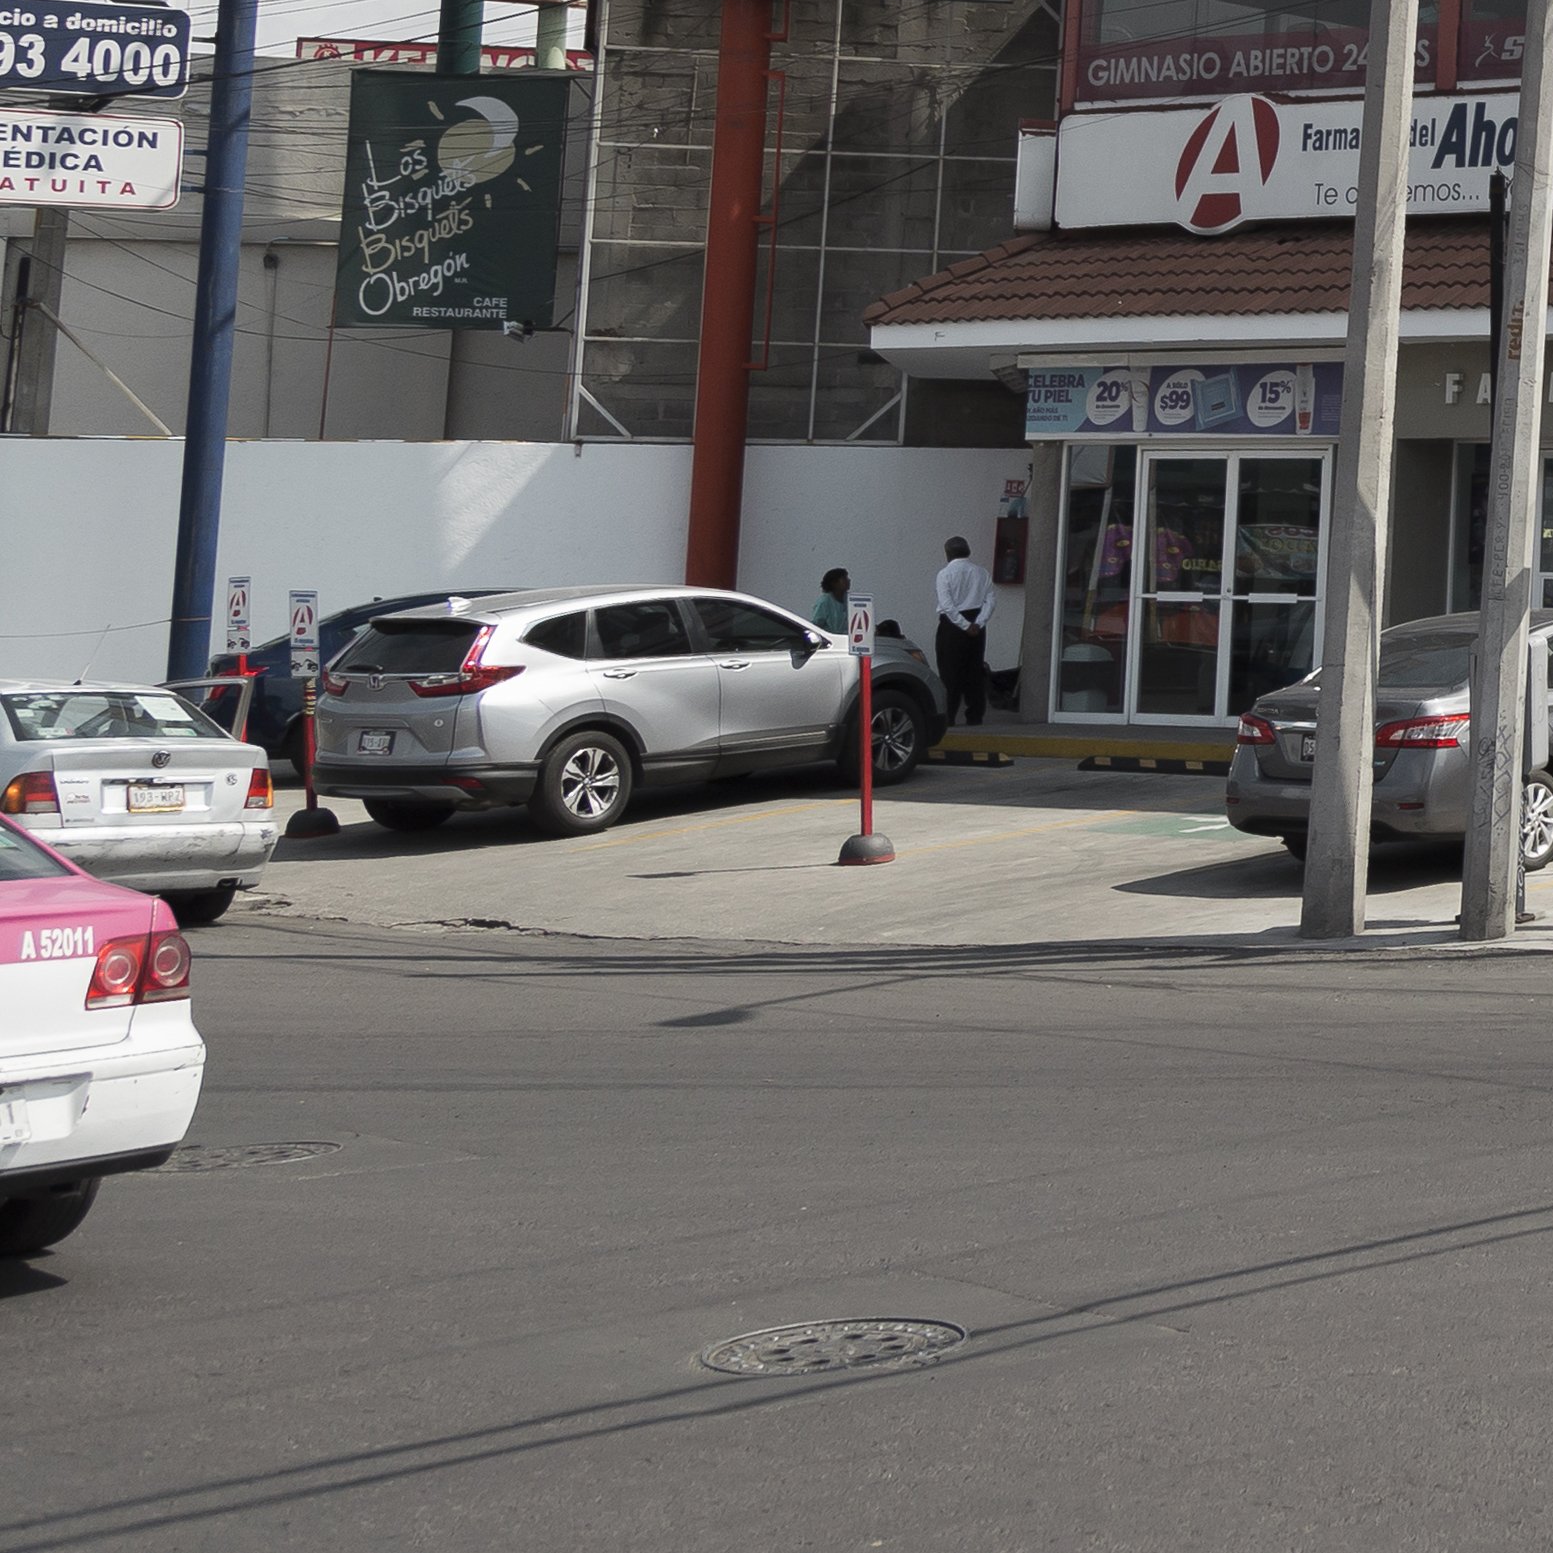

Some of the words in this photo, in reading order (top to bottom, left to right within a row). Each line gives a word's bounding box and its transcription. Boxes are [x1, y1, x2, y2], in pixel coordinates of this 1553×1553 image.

[43, 13, 59, 29] a
[66, 12, 178, 38] domicilio
[60, 37, 182, 87] 4000
[1088, 52, 1220, 87] GIMNASIO
[1230, 45, 1335, 78] ABIERTO
[365, 139, 430, 191] Los
[362, 155, 477, 232] Bisquets
[1315, 184, 1339, 207] Te
[358, 197, 475, 274] Bisquets
[359, 252, 471, 316] Obregón
[412, 307, 508, 319] RESTAURANTE
[473, 297, 508, 308] CAFE
[1044, 389, 1073, 404] PIEL
[1160, 390, 1191, 412] $99
[20, 930, 37, 960] A
[40, 926, 95, 960] 52011
